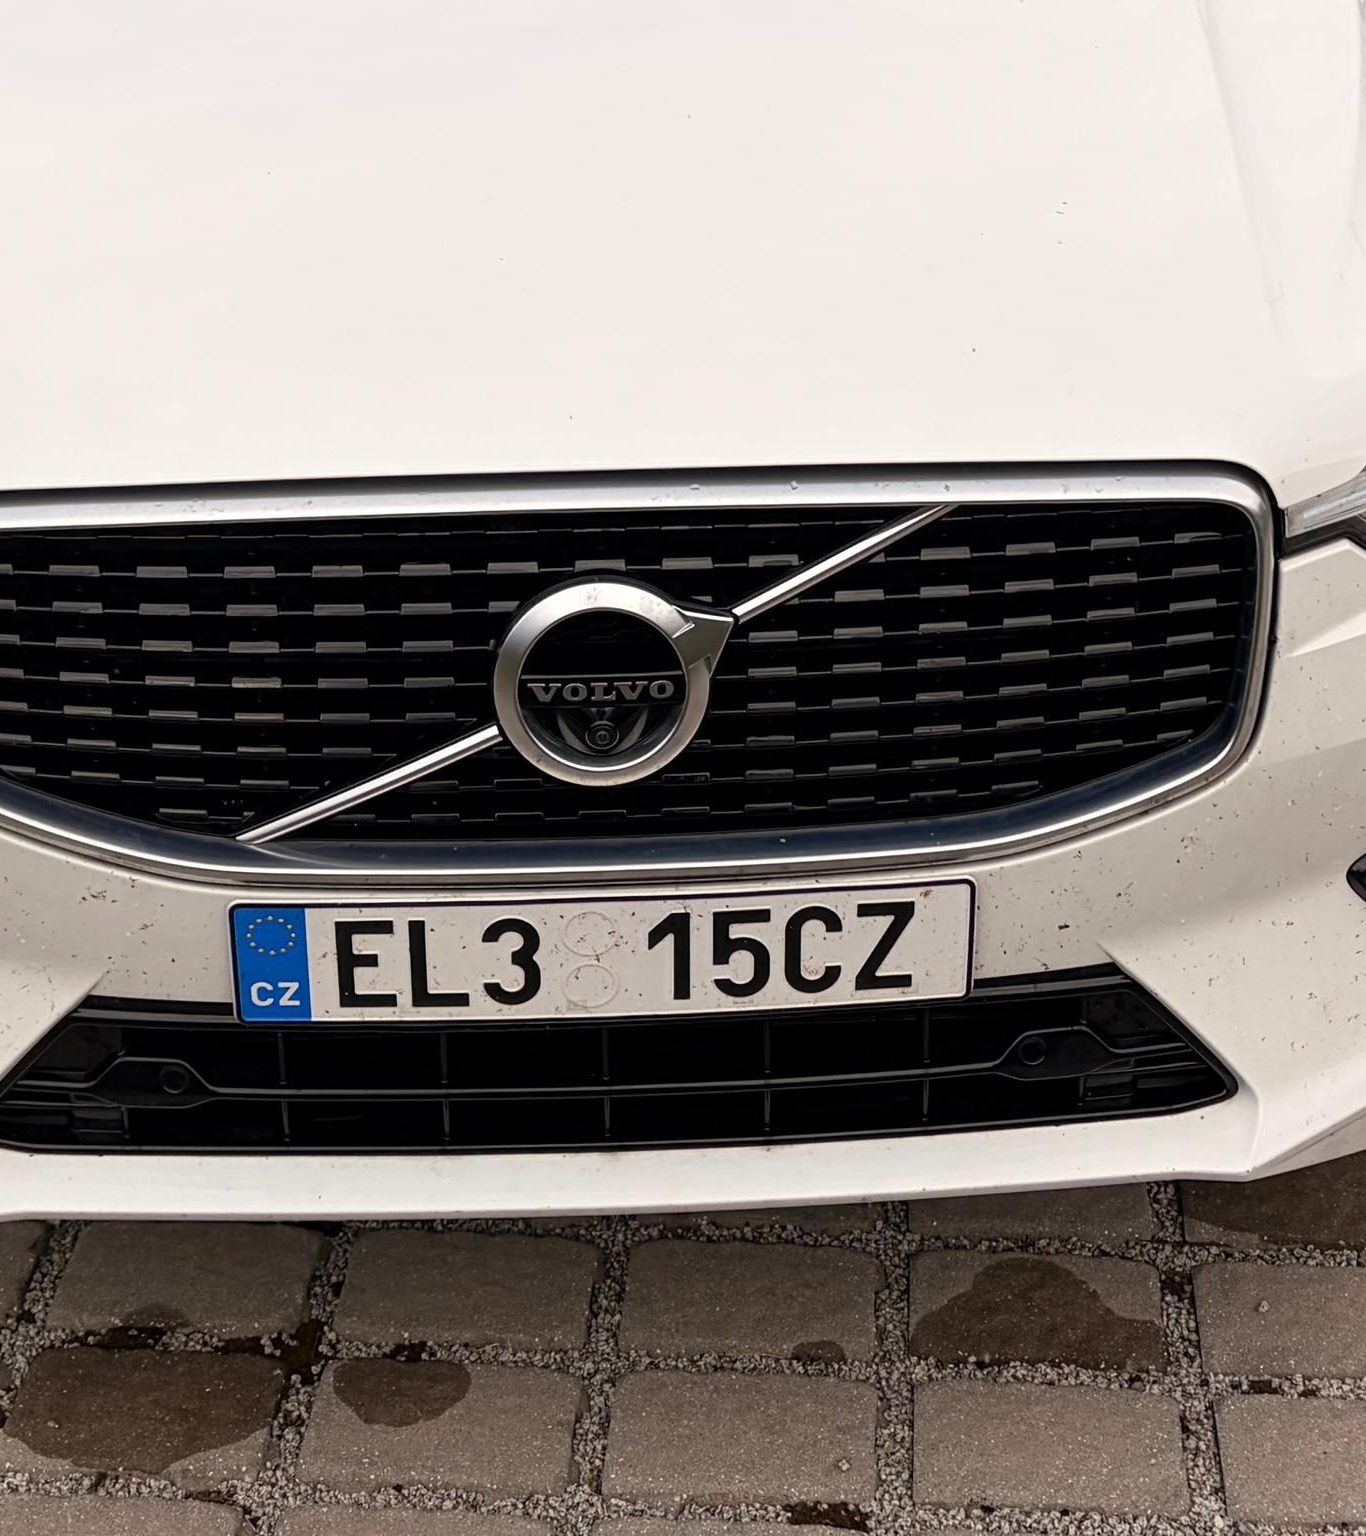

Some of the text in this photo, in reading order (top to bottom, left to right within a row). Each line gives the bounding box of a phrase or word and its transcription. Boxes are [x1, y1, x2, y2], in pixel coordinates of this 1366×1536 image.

[527, 680, 674, 703] VOLVO
[334, 900, 916, 1008] EL3 15CZ
[250, 981, 300, 1006] CZ
